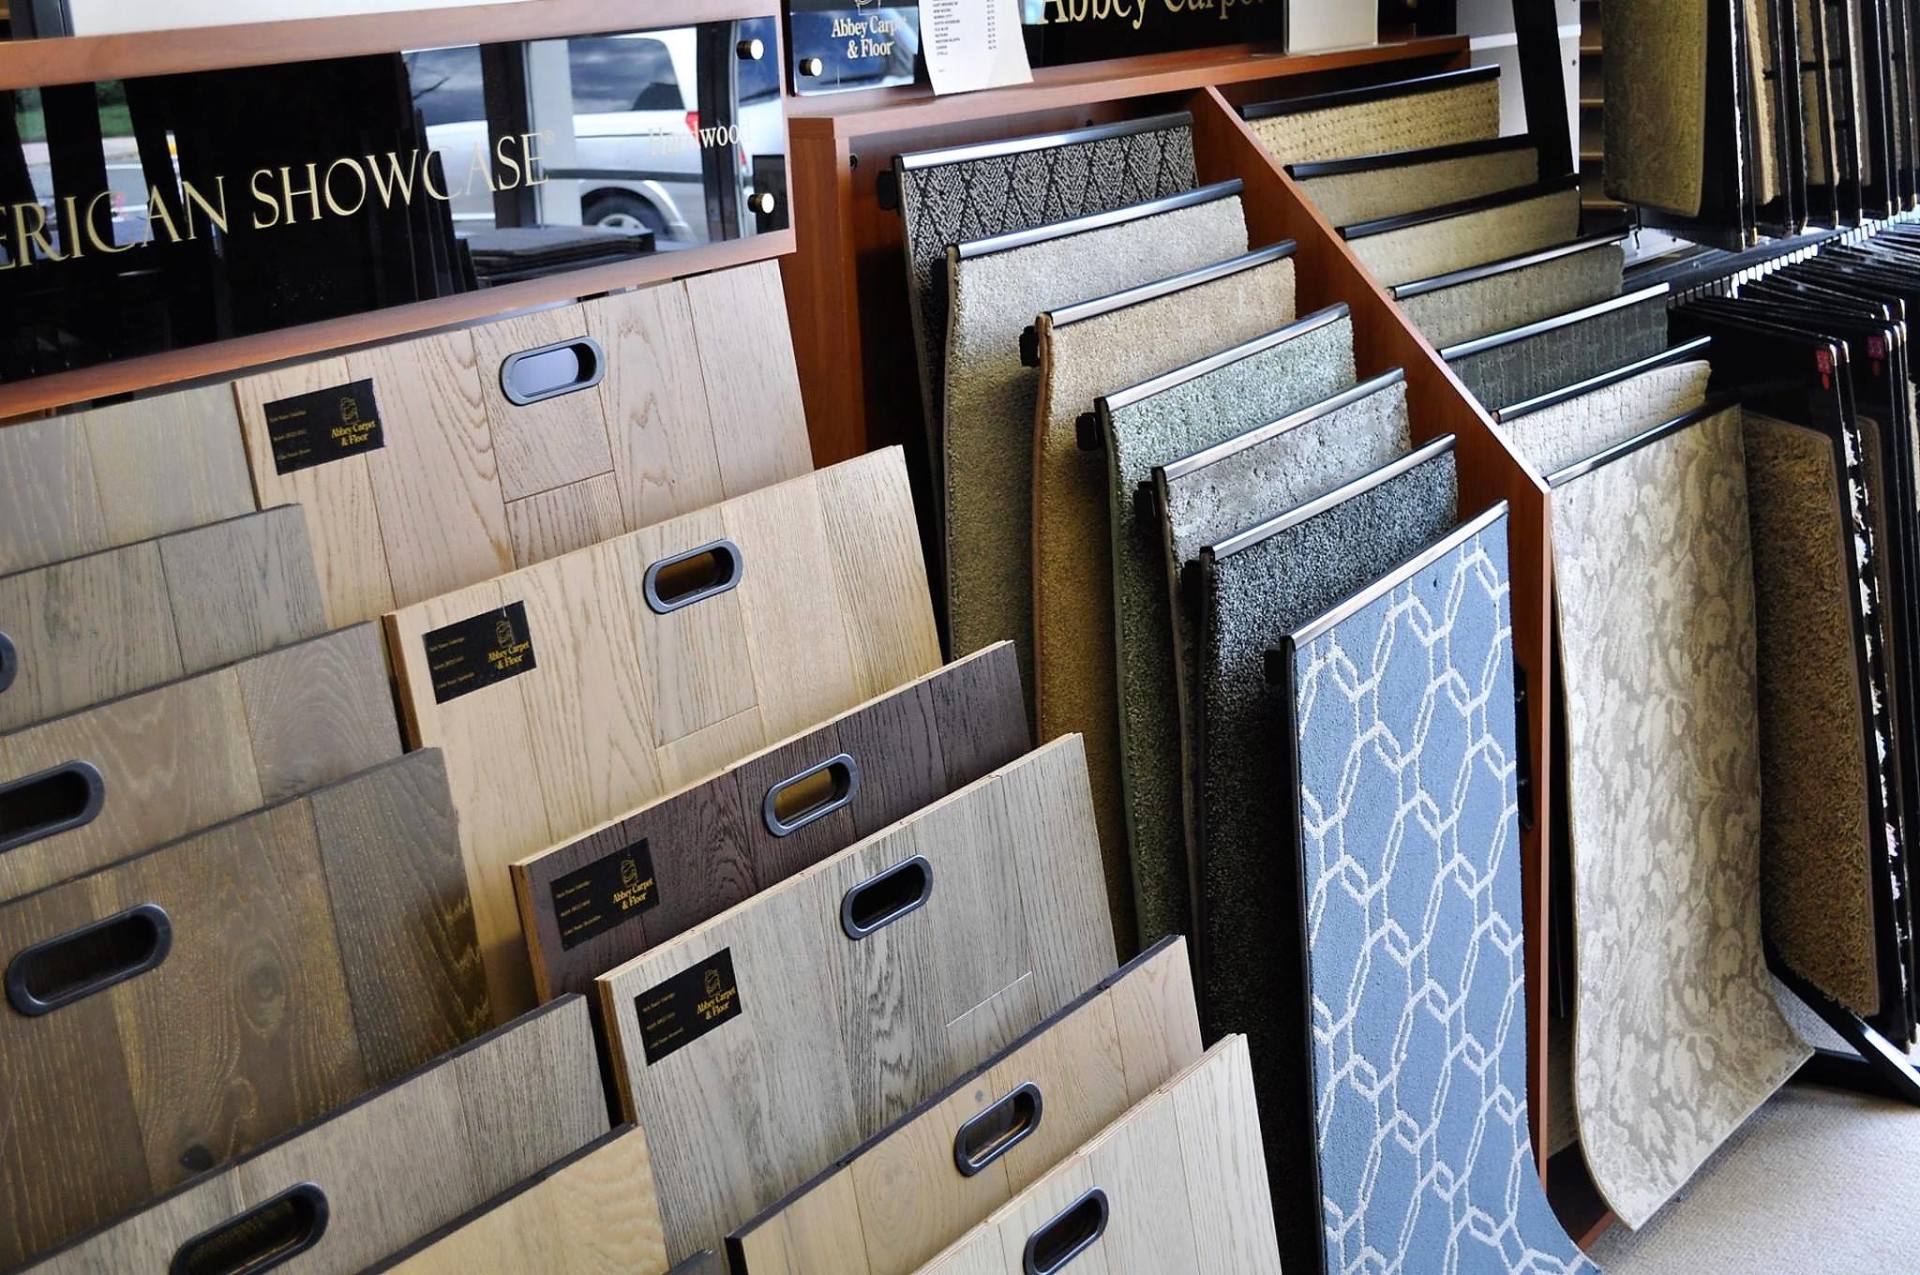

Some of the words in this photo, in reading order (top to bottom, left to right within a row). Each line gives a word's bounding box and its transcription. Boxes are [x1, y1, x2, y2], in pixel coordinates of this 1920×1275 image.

[832, 18, 867, 38] Abbey
[869, 15, 907, 36] Carp
[847, 39, 858, 59] &
[860, 38, 895, 58] Floor
[251, 132, 549, 229] SHOWCASE
